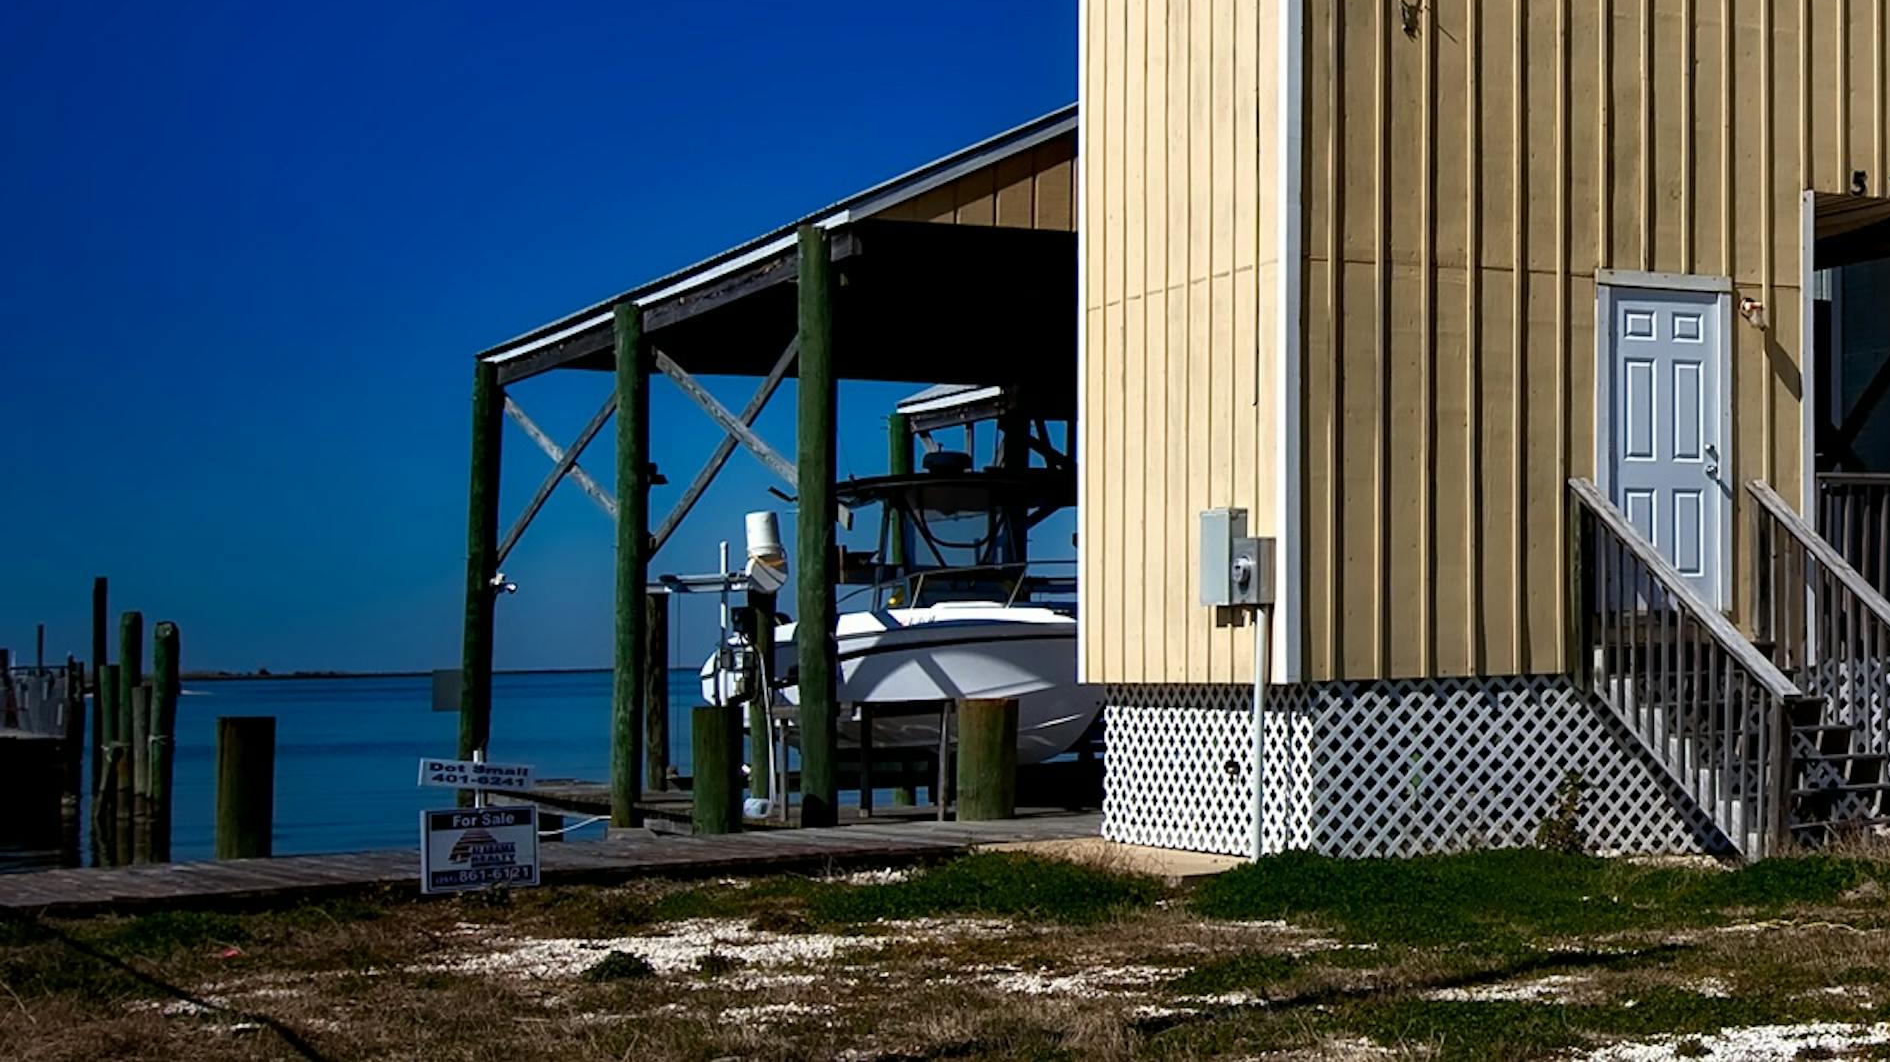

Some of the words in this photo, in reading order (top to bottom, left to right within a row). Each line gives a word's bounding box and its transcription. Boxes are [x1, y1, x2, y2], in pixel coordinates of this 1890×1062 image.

[429, 762, 465, 772] Dot
[473, 764, 528, 776] Small
[431, 772, 524, 787] 401-6241
[452, 814, 477, 827] For
[481, 812, 515, 825] Sale
